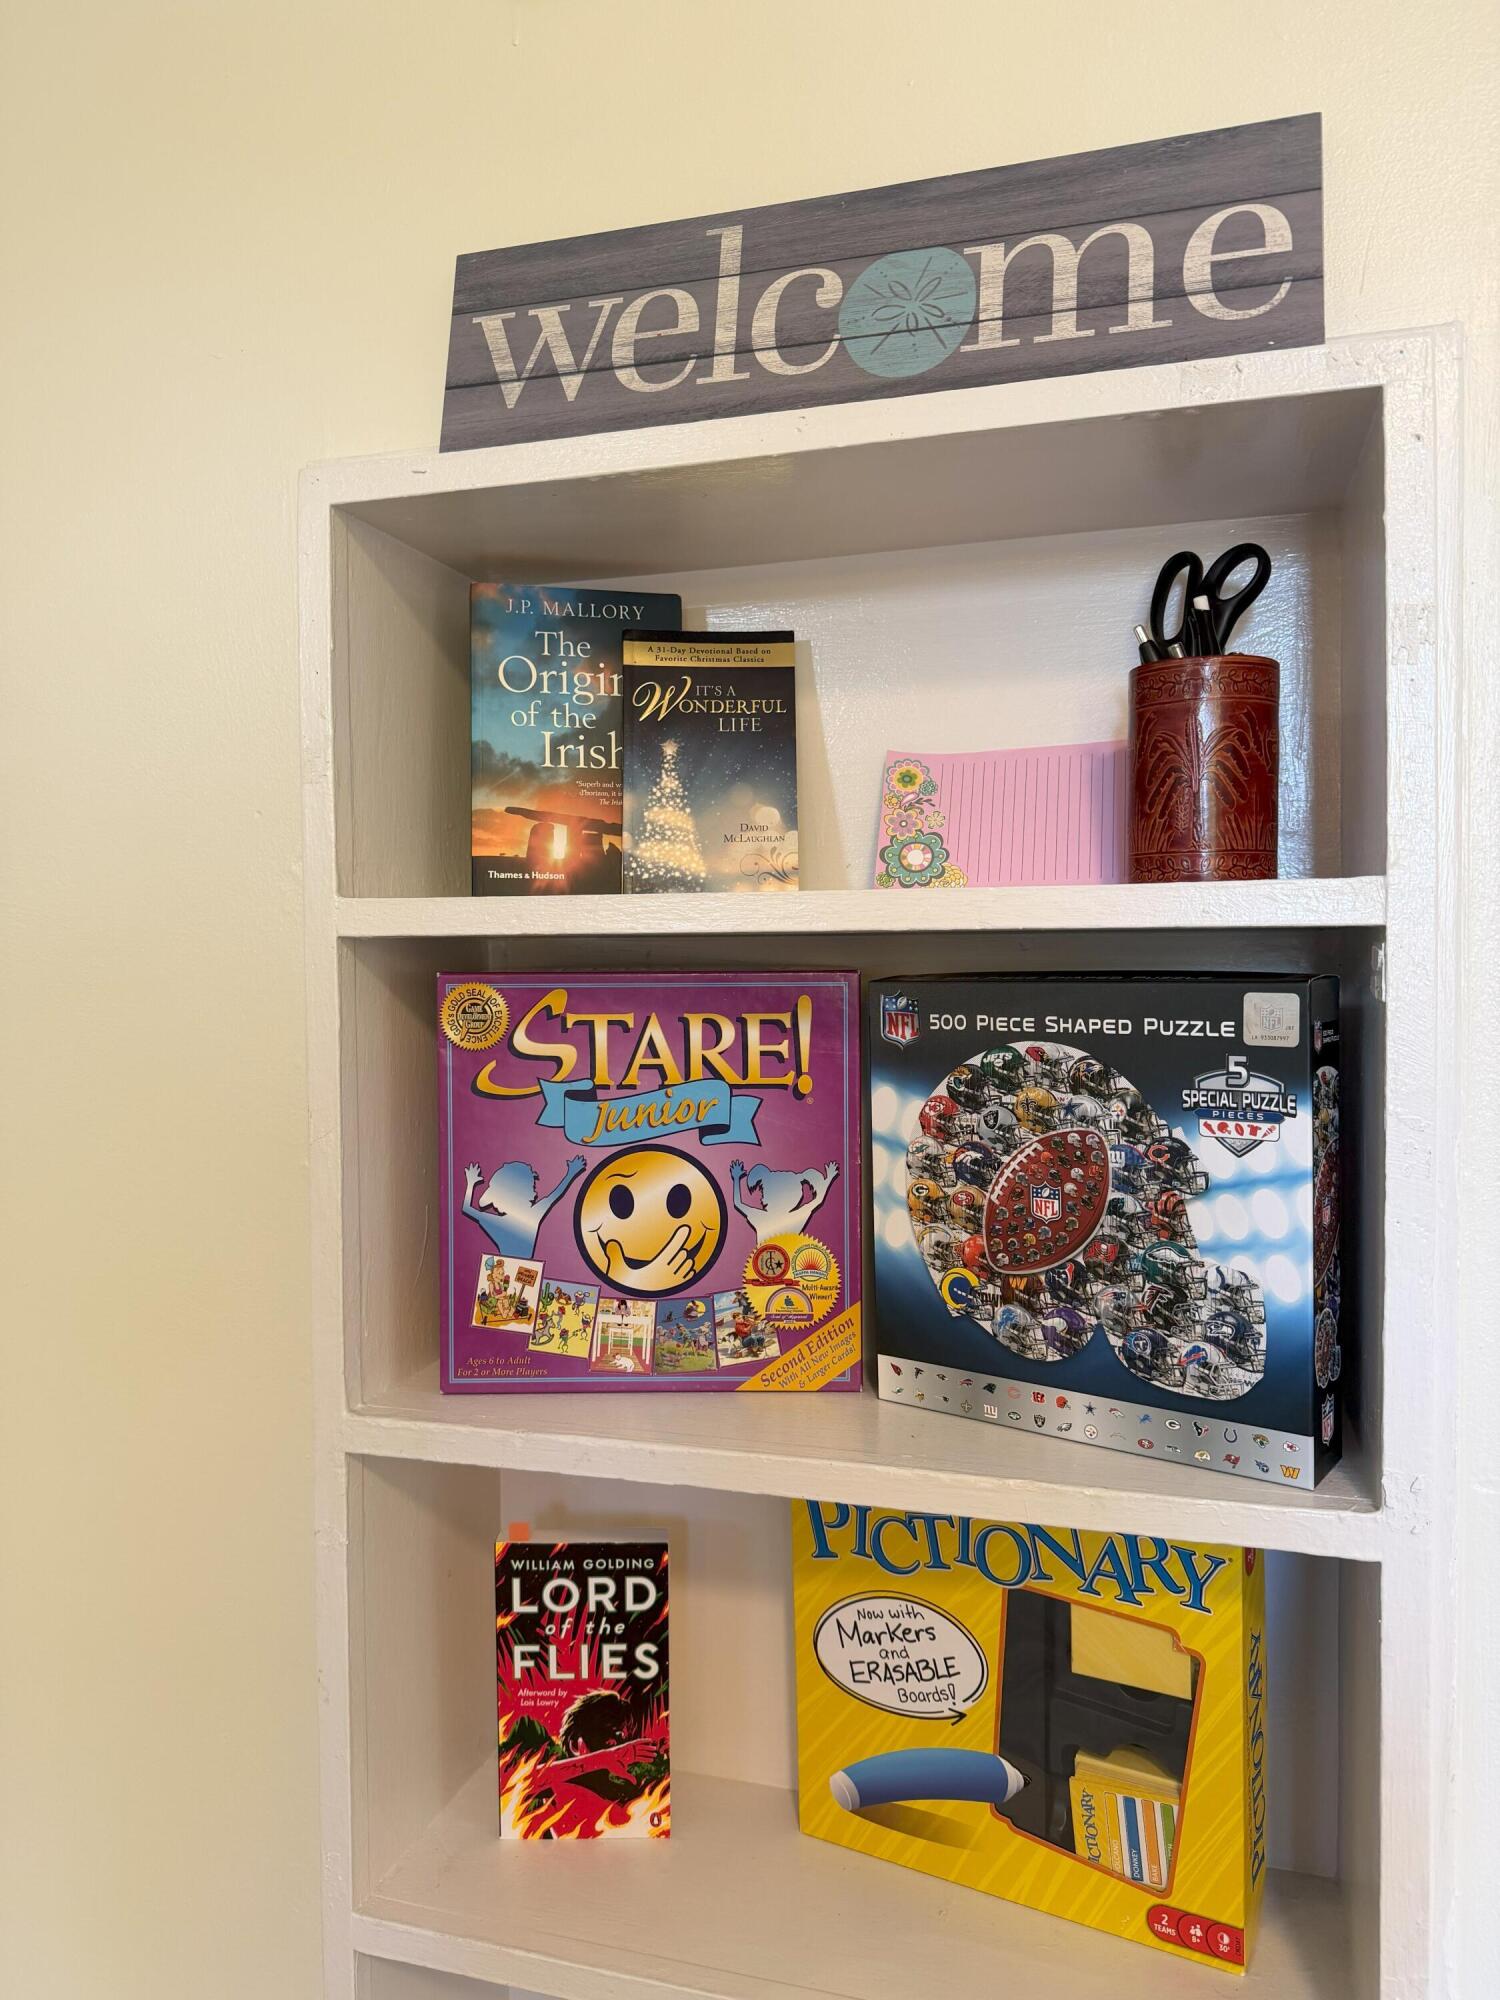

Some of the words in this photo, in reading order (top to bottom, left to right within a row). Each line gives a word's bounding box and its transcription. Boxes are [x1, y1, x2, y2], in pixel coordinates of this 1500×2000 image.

[506, 599, 533, 614] J.P.
[543, 601, 645, 620] MALLORY
[534, 630, 591, 658] The
[656, 646, 686, 655] 31-Day
[655, 654, 687, 662] Favorite
[733, 655, 765, 663] Classics
[632, 675, 787, 722] WONDERFUL
[696, 685, 722, 697] IT'S
[727, 686, 736, 697] A
[511, 700, 541, 727] of
[551, 703, 597, 729] the
[719, 717, 762, 732] LIFE
[488, 870, 523, 880] Thames
[524, 872, 530, 880] &
[531, 871, 565, 880] Hudson
[448, 991, 466, 1012] GOLD
[466, 988, 486, 999] SEAL
[490, 997, 501, 1009] OF
[465, 1010, 503, 1043] EXCELLENCE
[887, 1011, 920, 1040] NFL
[929, 1013, 967, 1030] 500
[976, 1014, 1036, 1033] PIECE
[1045, 1015, 1132, 1035] SHAPED
[1144, 1017, 1235, 1038] PUZZLE
[473, 988, 813, 1097] STARE!
[983, 1052, 1013, 1062] JETS
[1226, 1054, 1248, 1087] 5
[1182, 1089, 1237, 1109] SPECIAL
[1242, 1094, 1297, 1116] PUZZLE
[582, 1089, 718, 1143] Junior
[1212, 1110, 1264, 1121] PIECES
[1033, 1200, 1058, 1217] NFL
[466, 1356, 486, 1367] Ages
[488, 1356, 494, 1365] 6
[496, 1357, 505, 1365] to
[507, 1355, 531, 1365] Adult
[760, 1348, 806, 1387] Second
[805, 1317, 855, 1356] Edition
[778, 1372, 799, 1388] With
[800, 1363, 812, 1376] All
[811, 1351, 829, 1369] New
[829, 1331, 857, 1353] Images
[457, 1368, 472, 1376] For
[473, 1368, 479, 1376] 2
[492, 1367, 514, 1376] More
[516, 1367, 548, 1378] Players
[806, 1363, 831, 1383] Larger
[831, 1344, 856, 1365] Cards!
[511, 1559, 575, 1571] WILLIAM
[583, 1558, 655, 1570] GOLDING
[806, 1500, 1226, 1614] PICTIONARY
[511, 1575, 657, 1613] LORD
[857, 1608, 884, 1621] Now
[888, 1604, 925, 1620] with
[545, 1617, 574, 1639] of
[586, 1616, 626, 1635] the
[513, 1642, 660, 1680] FLIES
[879, 1645, 910, 1659] and
[849, 1656, 961, 1685] ERASABLE
[517, 1688, 556, 1697] Afterword
[558, 1688, 568, 1698] by
[520, 1698, 535, 1706] Lois
[537, 1698, 559, 1708] Lowry
[897, 1683, 957, 1706] Boards!
[1248, 1632, 1266, 1892] PICTIONARY
[1130, 1848, 1141, 1878] DONKEY
[1154, 1923, 1177, 1937] TEAMS
[1161, 1913, 1169, 1926] 2
